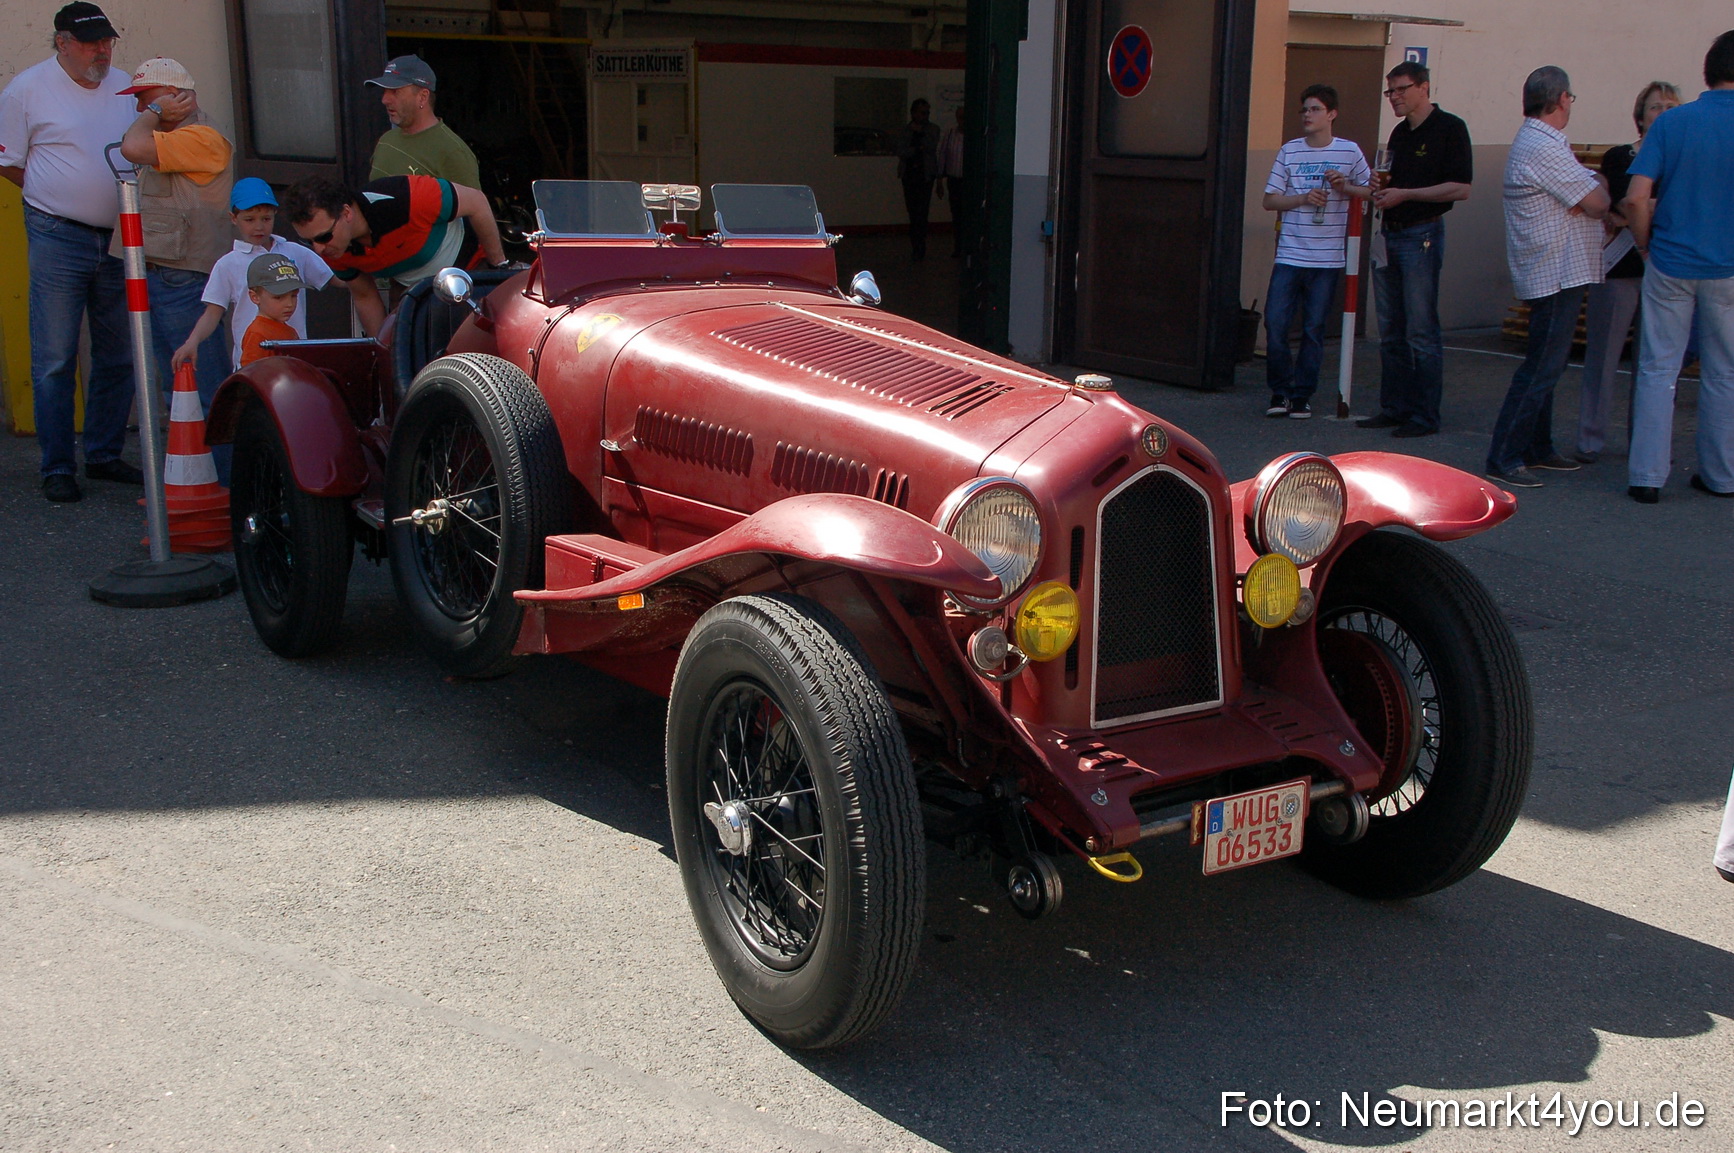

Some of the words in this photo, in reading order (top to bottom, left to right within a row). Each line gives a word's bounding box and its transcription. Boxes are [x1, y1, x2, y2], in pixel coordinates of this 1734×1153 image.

[1212, 821, 1219, 832] D
[1233, 793, 1279, 830] WUG
[1217, 822, 1293, 867] 06533
